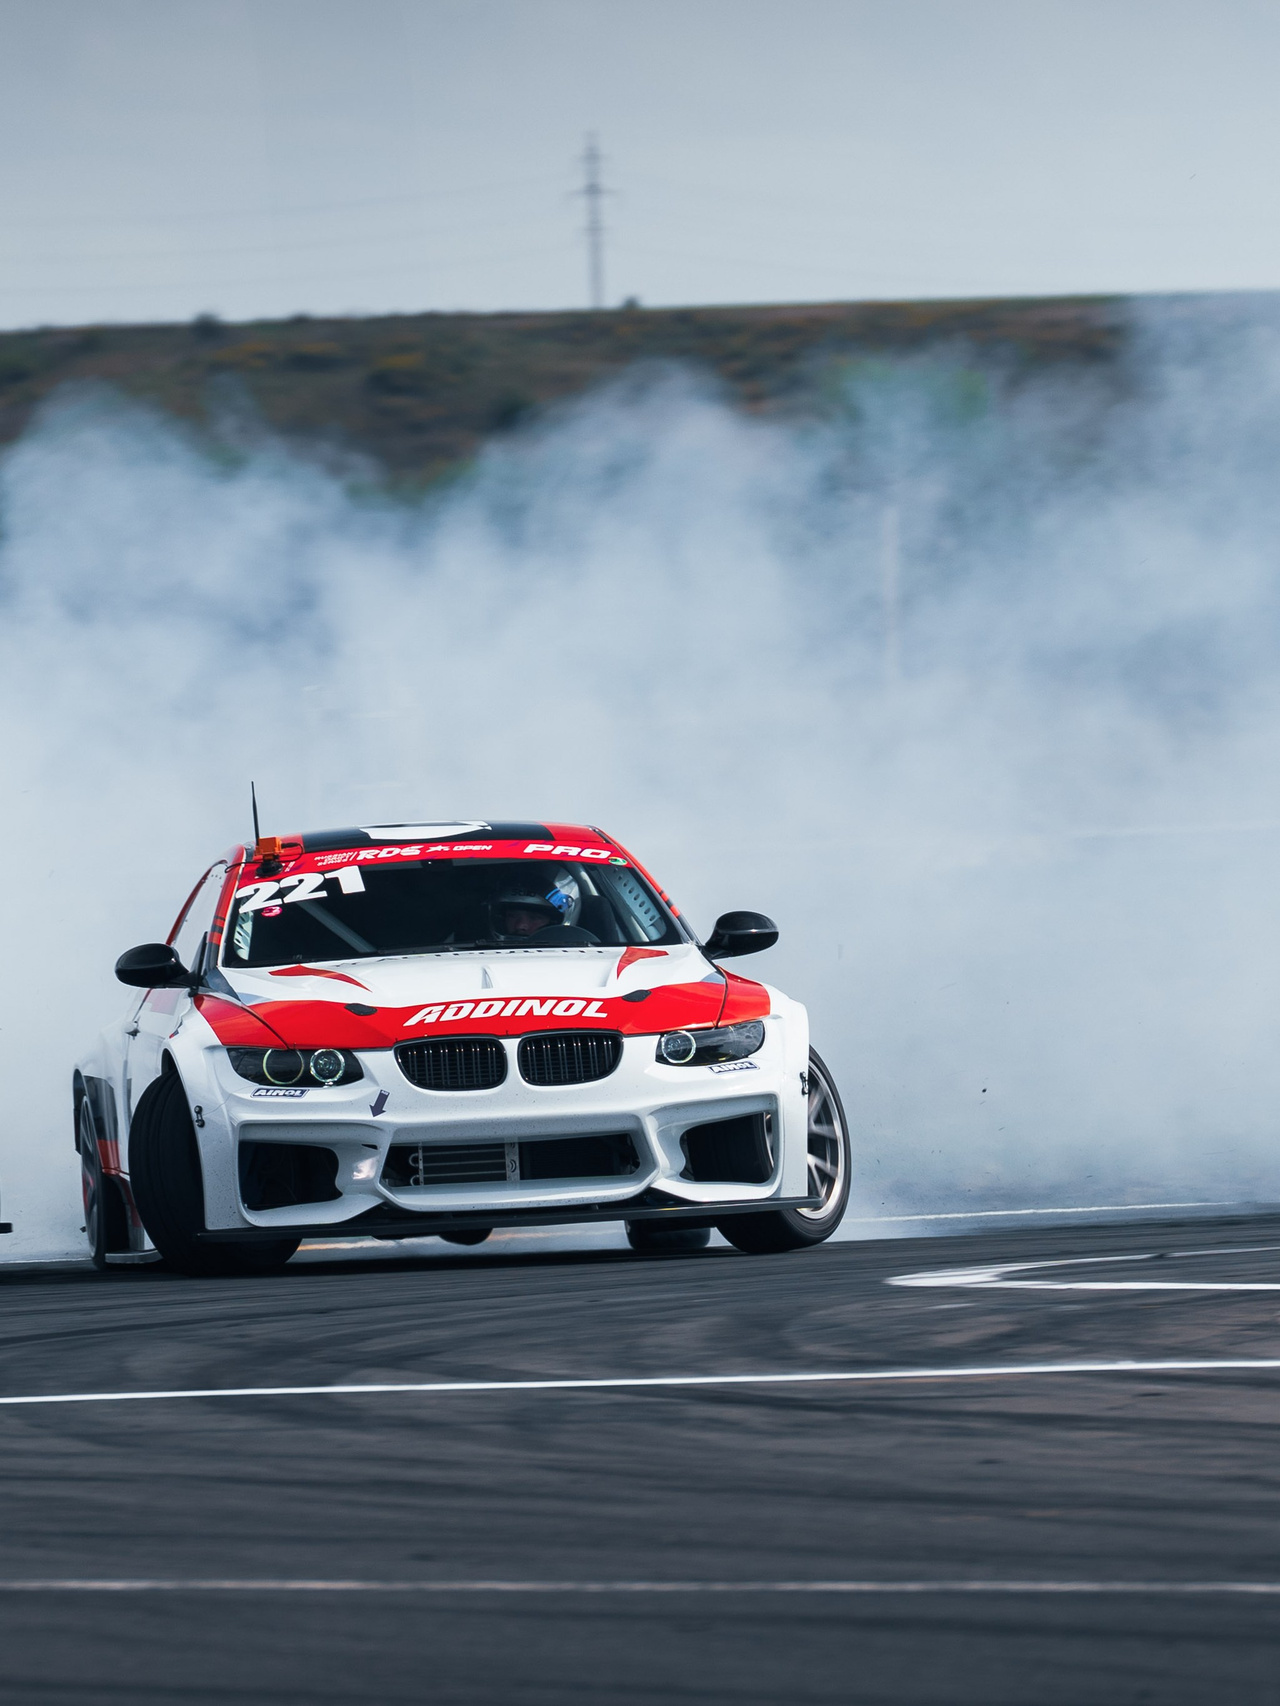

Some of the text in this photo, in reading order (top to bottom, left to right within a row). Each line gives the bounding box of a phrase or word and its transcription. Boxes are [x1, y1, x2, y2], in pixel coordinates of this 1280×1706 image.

[356, 845, 423, 861] RDS
[523, 843, 612, 859] PRO
[235, 865, 366, 914] 221
[402, 999, 608, 1027] ADDINOL
